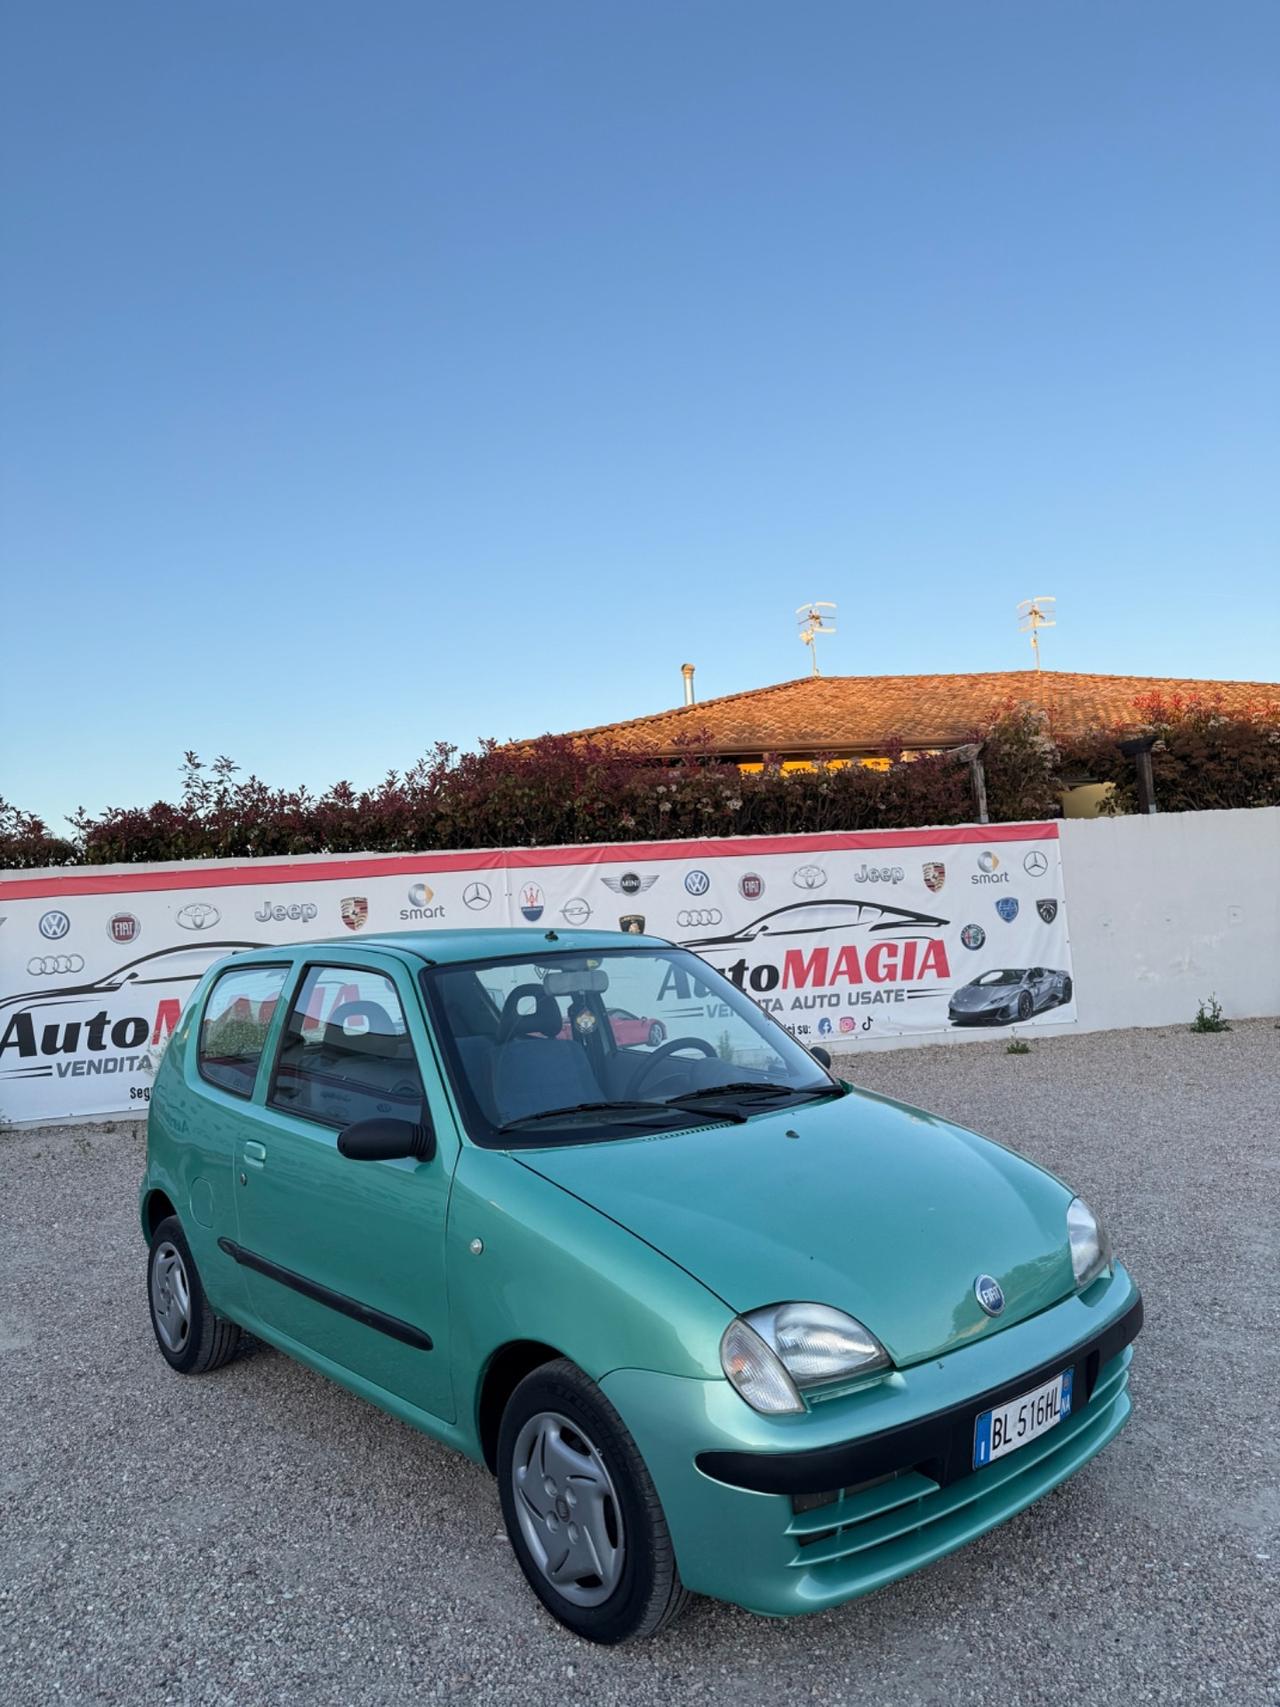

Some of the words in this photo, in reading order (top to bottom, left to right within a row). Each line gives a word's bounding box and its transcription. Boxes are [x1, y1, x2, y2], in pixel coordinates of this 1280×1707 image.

[854, 864, 905, 885] Jeep
[971, 871, 1010, 885] smart
[744, 879, 760, 894] FIAT
[254, 901, 318, 923] Jeep
[400, 905, 446, 921] smart
[114, 921, 134, 937] FIAT
[790, 992, 841, 1010] AUTO
[847, 988, 906, 1006] USATE
[55, 1055, 153, 1079] VENDITA
[981, 1286, 1002, 1305] FIAT
[992, 1413, 1013, 1451] BL
[1017, 1387, 1061, 1437] 516HL
